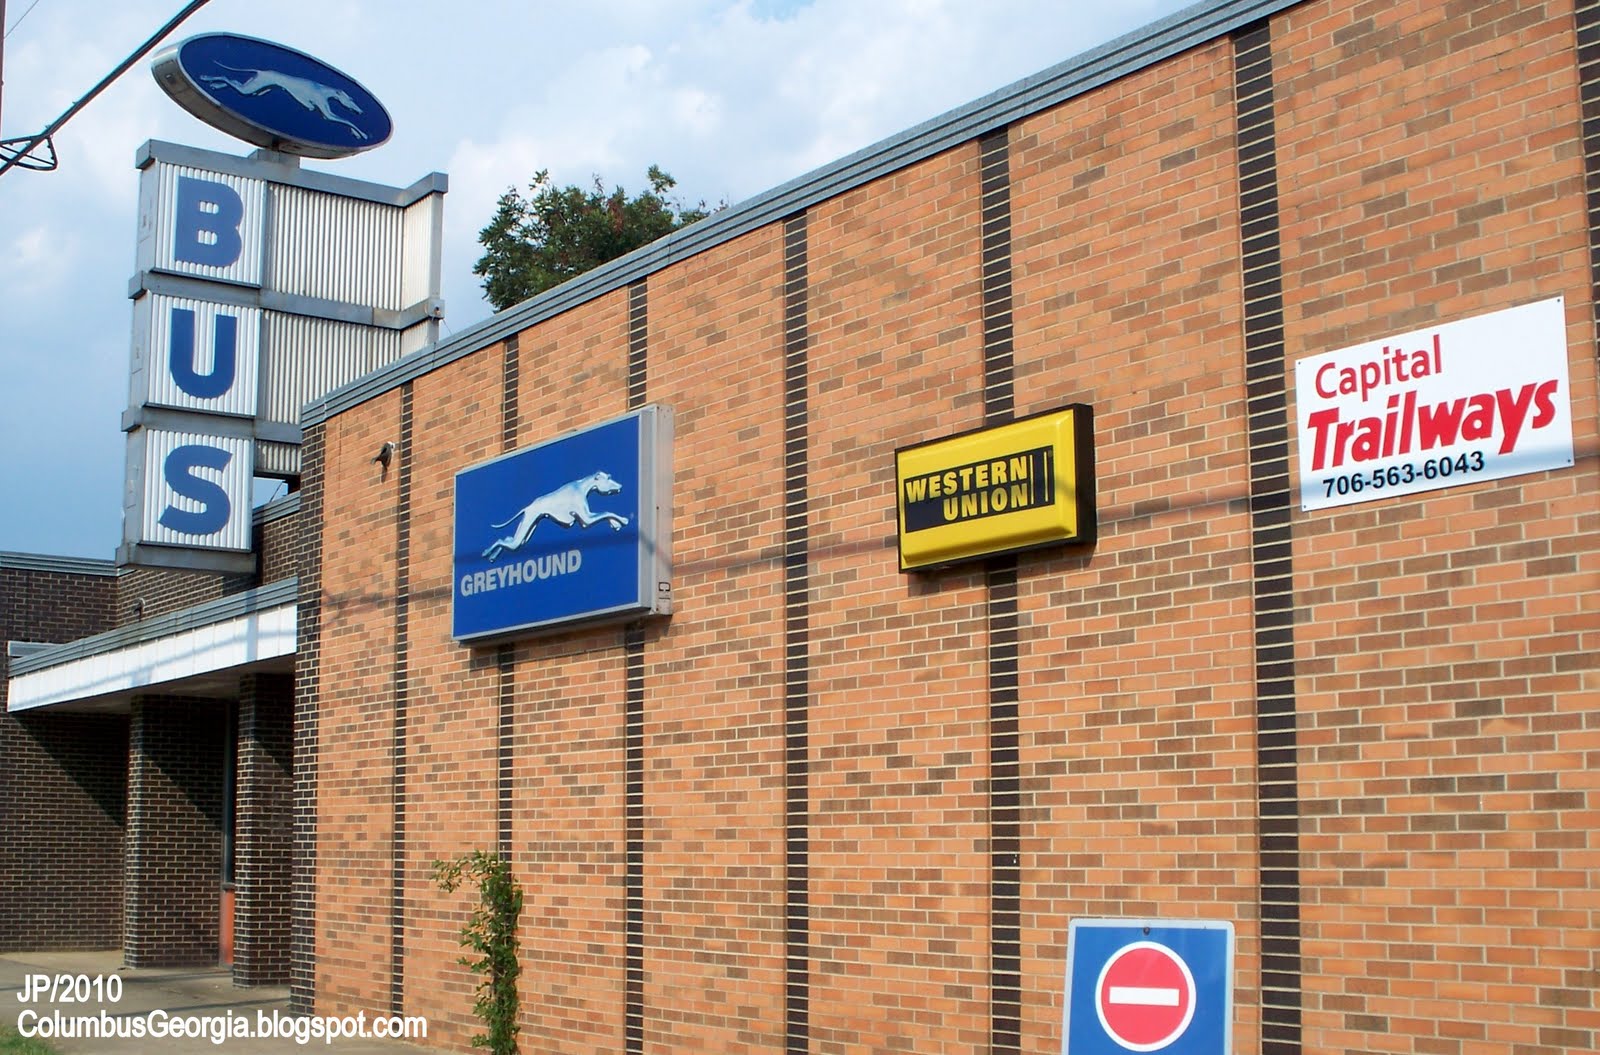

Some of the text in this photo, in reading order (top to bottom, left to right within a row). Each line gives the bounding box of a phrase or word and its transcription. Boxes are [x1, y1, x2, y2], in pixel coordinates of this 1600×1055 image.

[157, 175, 244, 535] BUS
[1315, 334, 1442, 402] Capital
[1307, 379, 1558, 471] Trailways
[905, 455, 1028, 503] WESTERN
[1322, 450, 1485, 498] 706-563-6043
[943, 483, 1028, 521] UNION
[460, 549, 582, 596] GREYHOUND
